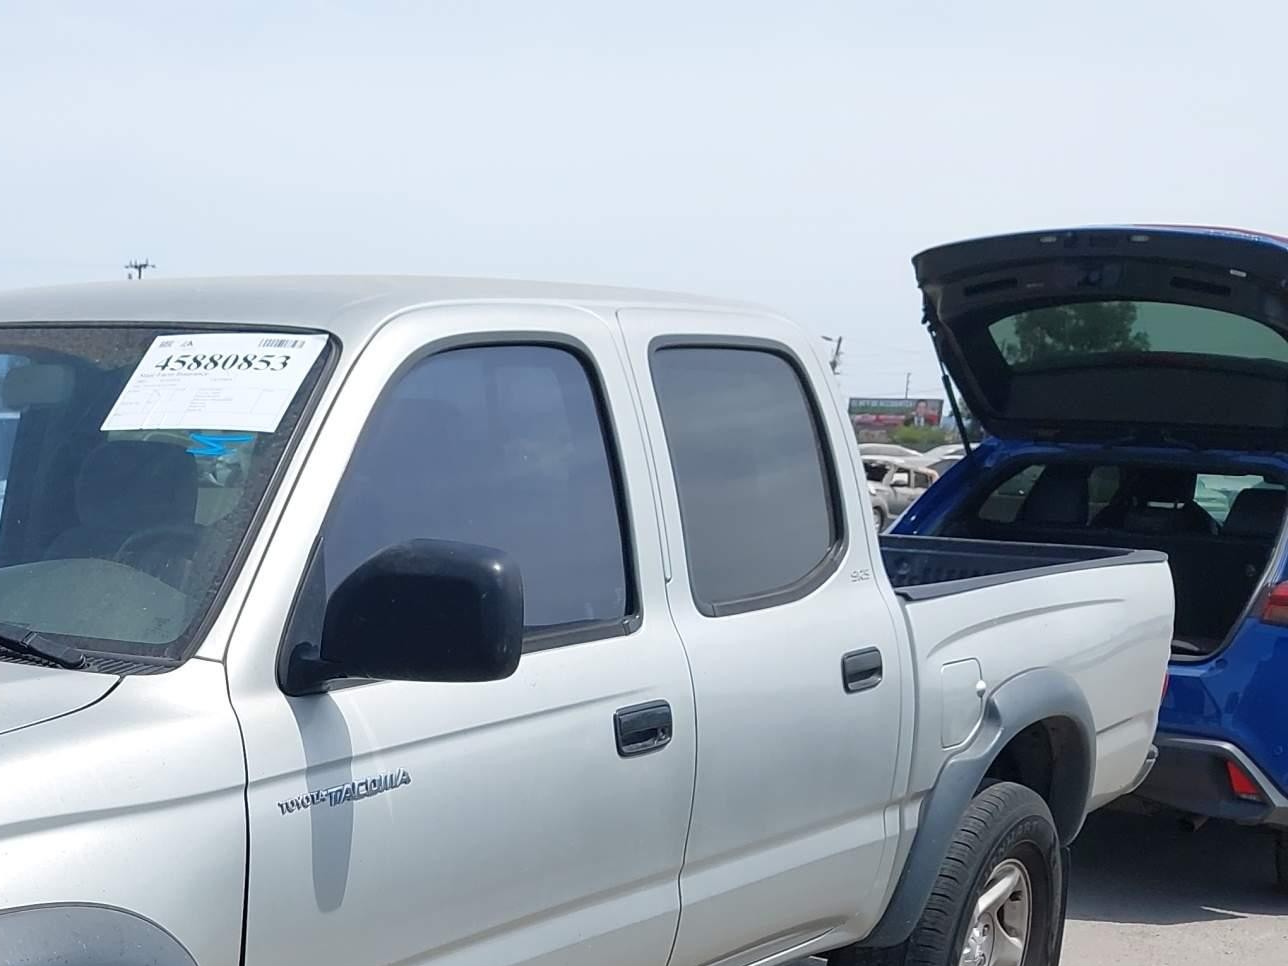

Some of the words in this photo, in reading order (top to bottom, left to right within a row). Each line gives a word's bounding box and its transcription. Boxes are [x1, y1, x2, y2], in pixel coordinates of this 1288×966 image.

[155, 353, 291, 372] 45880853
[277, 790, 328, 815] TOYOTA
[327, 768, 412, 807] TACOMA
